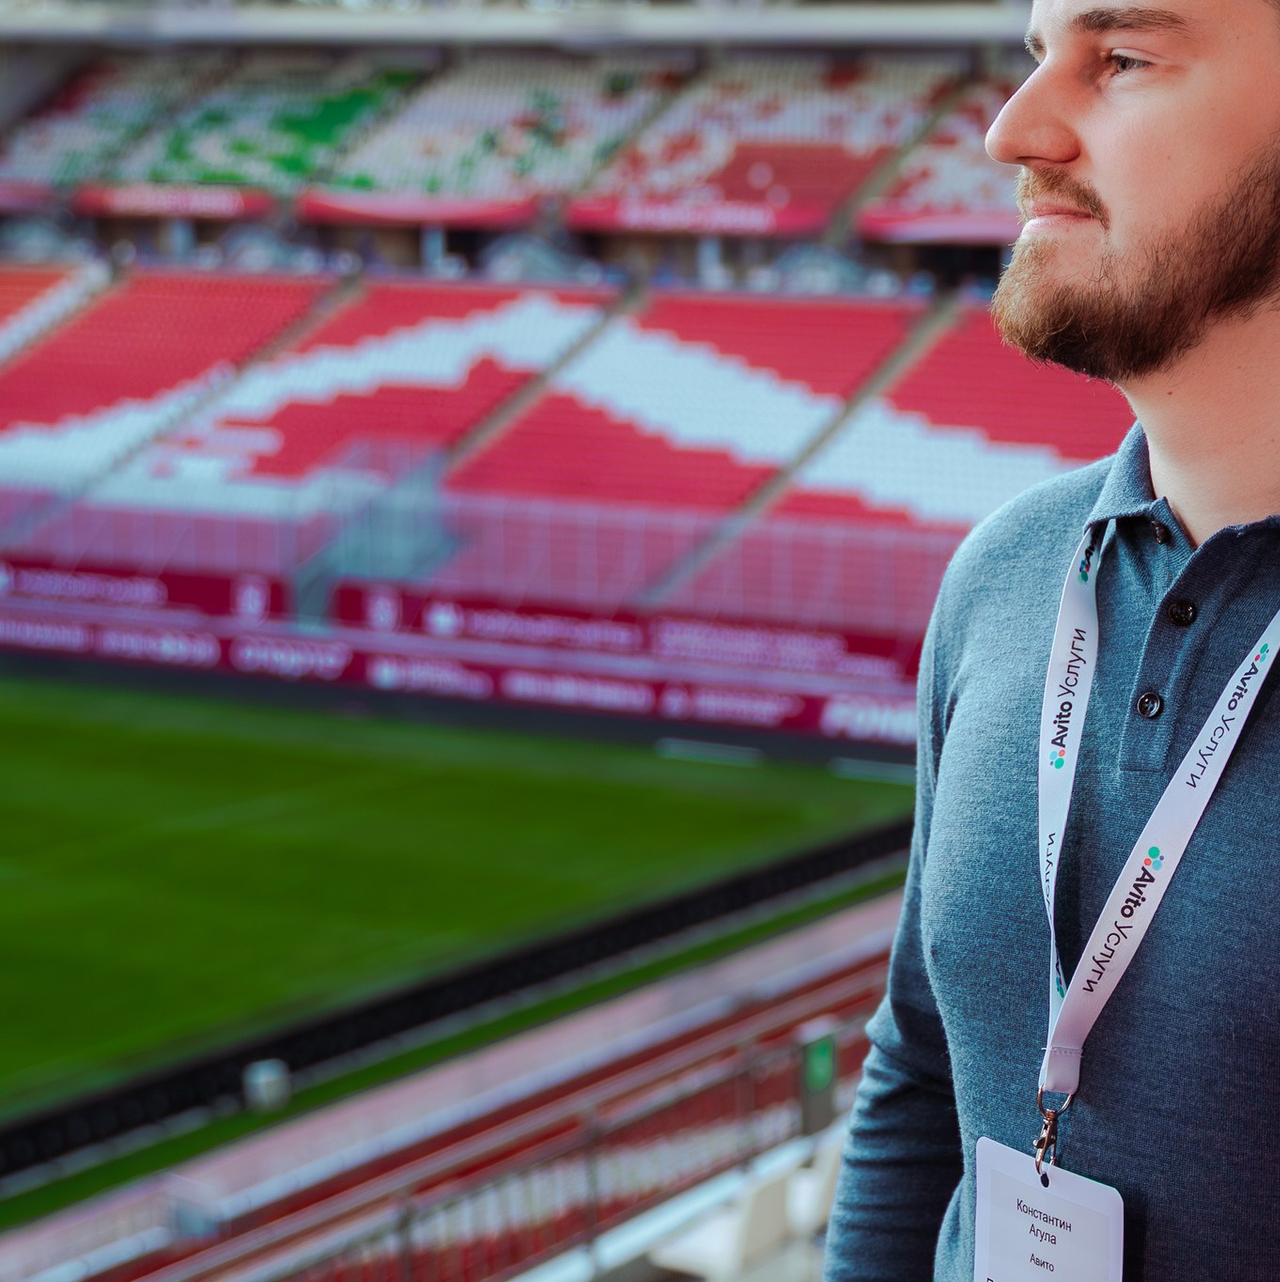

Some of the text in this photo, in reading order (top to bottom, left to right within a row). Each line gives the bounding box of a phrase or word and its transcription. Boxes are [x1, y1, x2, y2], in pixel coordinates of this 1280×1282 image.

[1051, 628, 1087, 748] Avito Услуги
[1186, 662, 1259, 789] Avito Услуги
[1082, 866, 1155, 993] Avito Услуги
[1016, 1198, 1072, 1232] Константин
[1029, 1224, 1057, 1245] Агула
[1030, 1253, 1054, 1272] Авито
